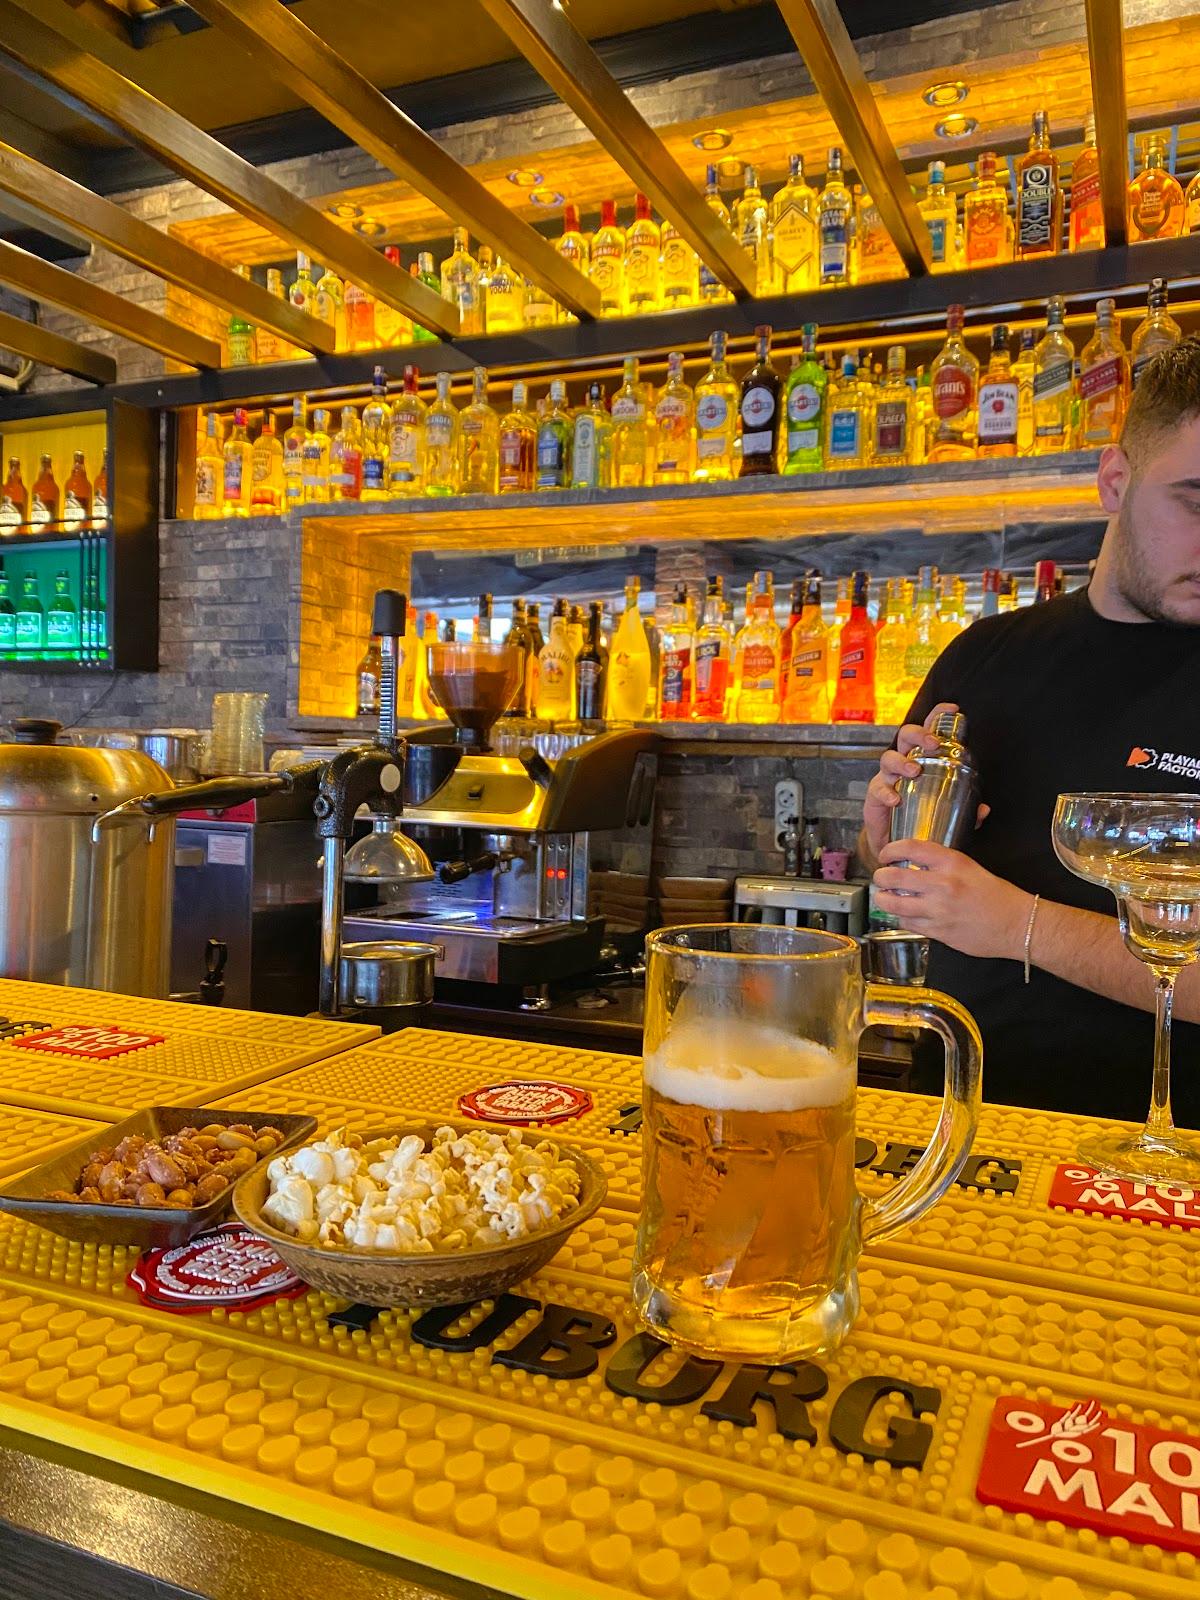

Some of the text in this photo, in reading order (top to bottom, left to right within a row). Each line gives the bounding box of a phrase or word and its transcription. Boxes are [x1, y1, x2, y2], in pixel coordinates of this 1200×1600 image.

[1157, 761, 1200, 780] FACTO
[1160, 752, 1200, 770] PLAYA
[29, 1036, 119, 1053] MALT
[61, 1027, 149, 1046] %100
[1064, 1169, 1195, 1202] %10
[1077, 1188, 1200, 1221] MAL
[1006, 1400, 1200, 1489] %10
[1023, 1458, 1200, 1535] MAL
